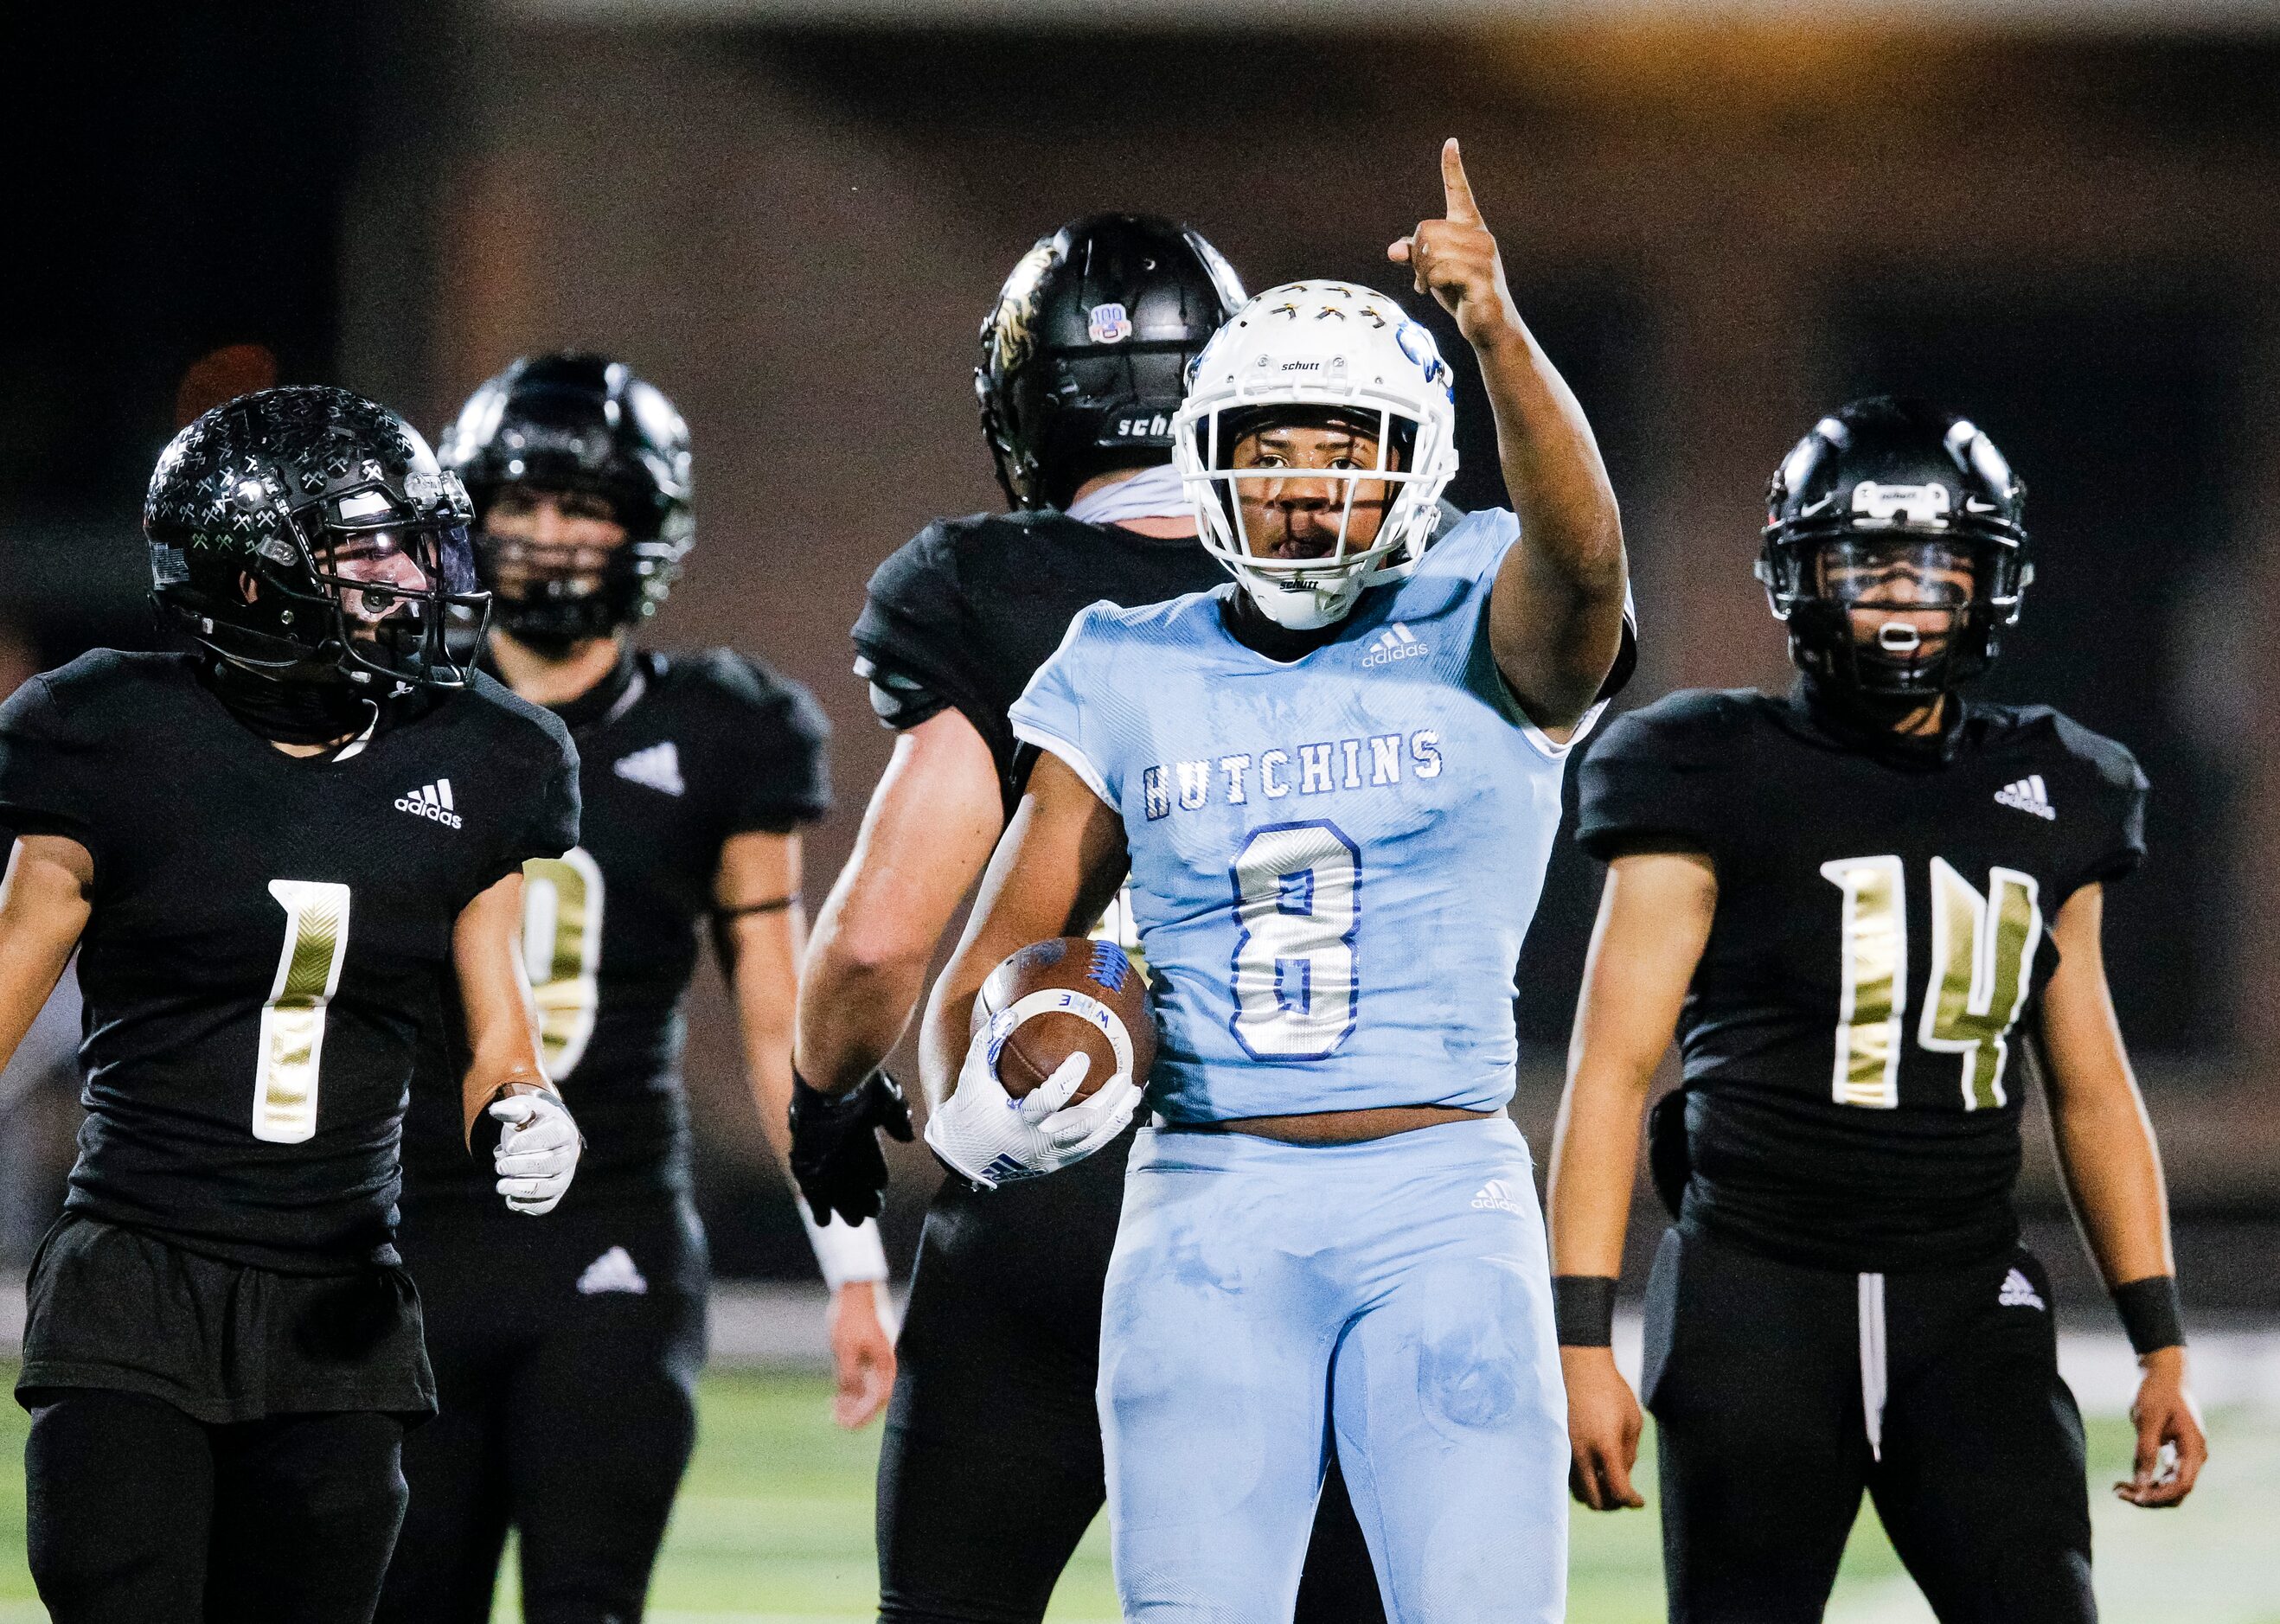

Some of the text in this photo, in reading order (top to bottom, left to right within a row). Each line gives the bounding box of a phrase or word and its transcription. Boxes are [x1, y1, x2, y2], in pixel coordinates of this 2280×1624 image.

[1095, 306, 1122, 325] 100
[1281, 361, 1320, 371] schutt
[1280, 579, 1319, 590] schutt
[1361, 642, 1429, 668] adidas
[1143, 729, 1443, 822] HUTCHINS
[394, 798, 462, 829] adidas
[1229, 818, 1362, 1062] 8
[1820, 854, 2043, 1112] 14
[253, 879, 350, 1143] 1
